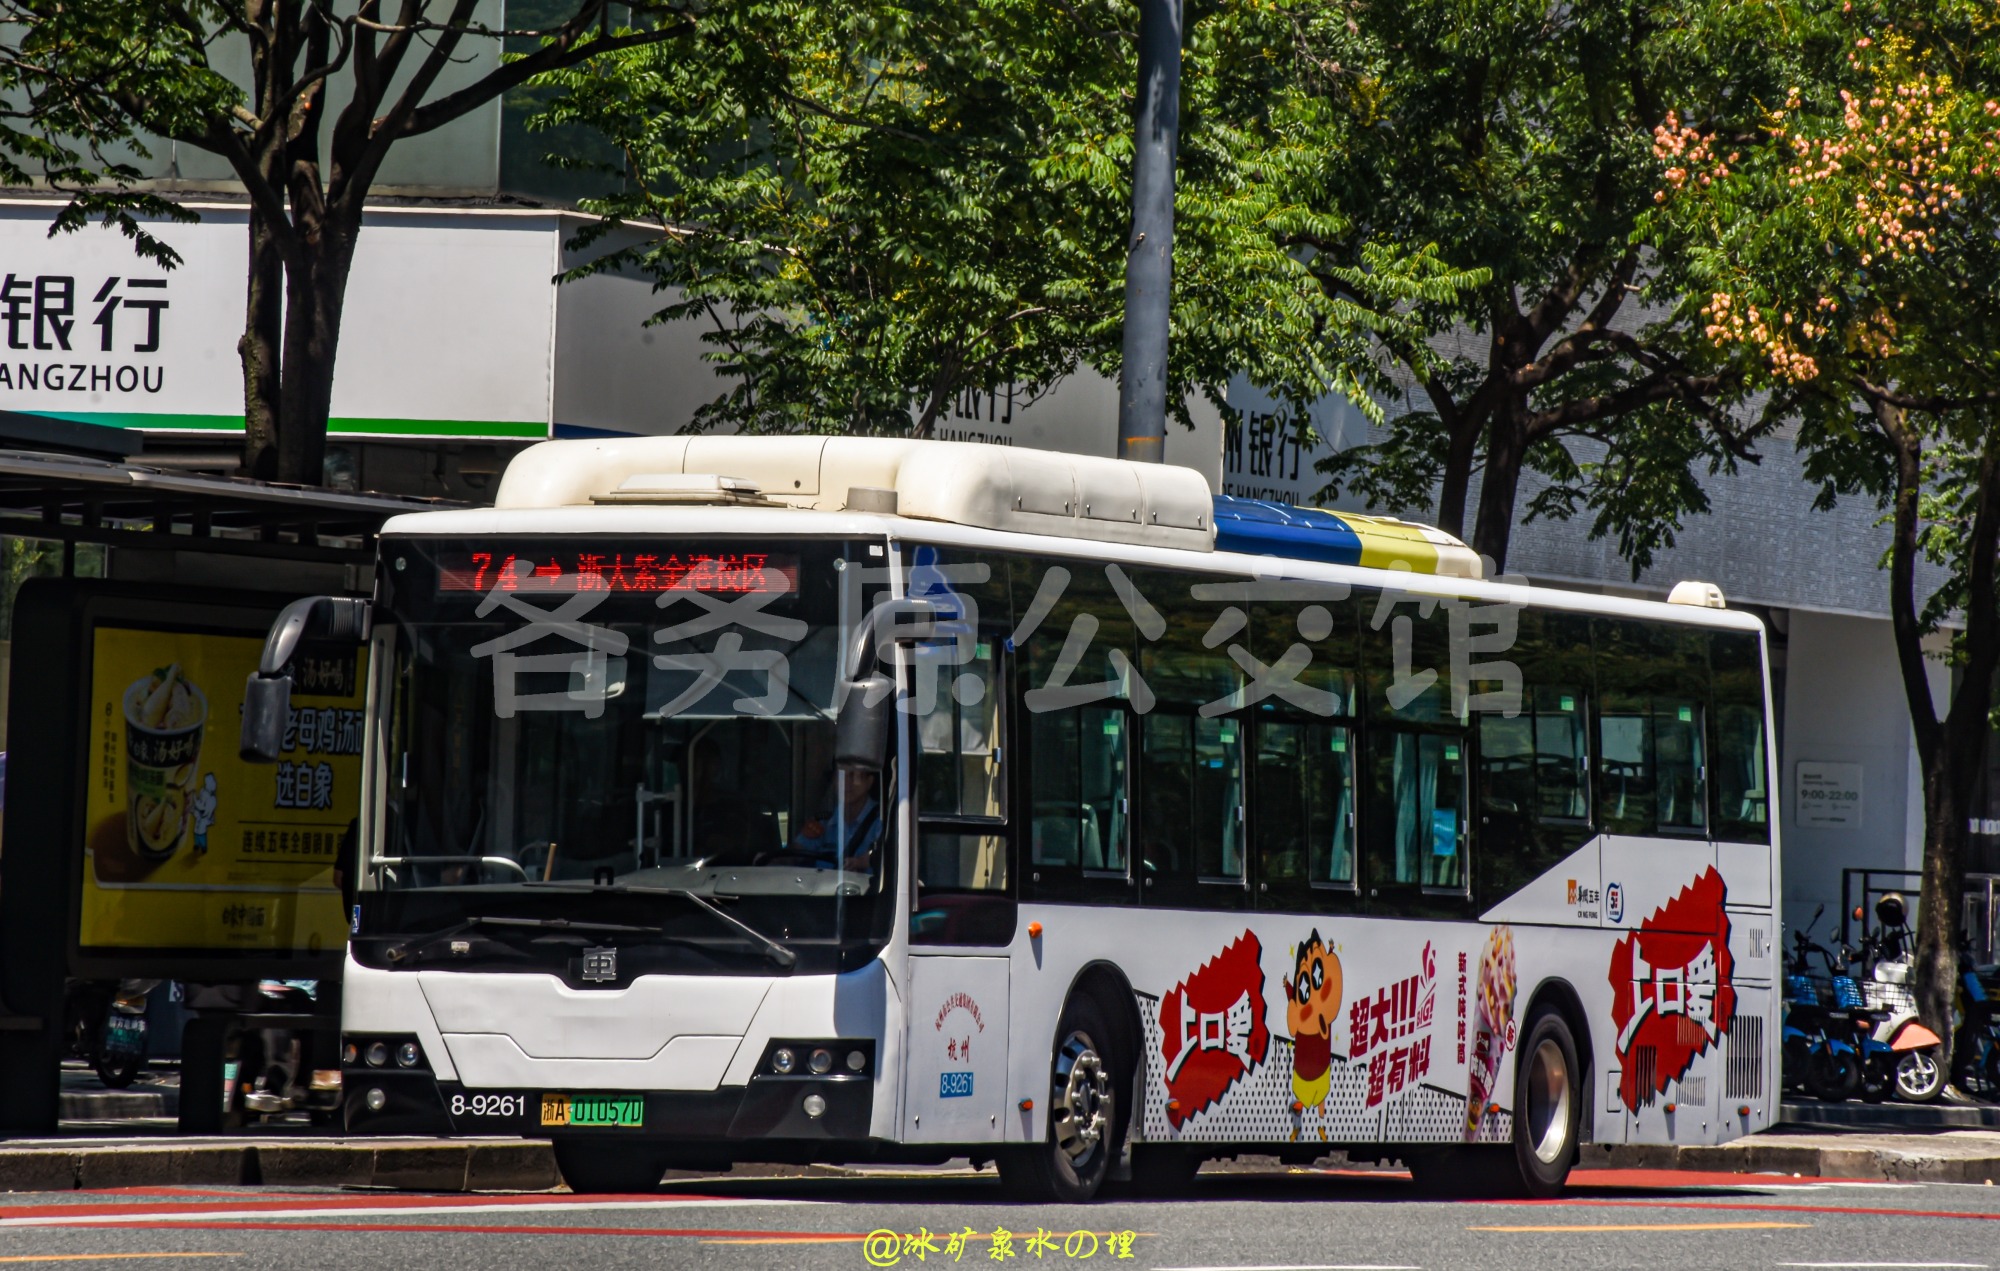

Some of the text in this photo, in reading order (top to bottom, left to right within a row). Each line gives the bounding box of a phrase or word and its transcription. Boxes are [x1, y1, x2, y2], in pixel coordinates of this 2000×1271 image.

[0, 273, 170, 353] 银行
[473, 553, 518, 591] 74
[274, 761, 333, 810] 选白象
[947, 1034, 970, 1064] 杭州
[941, 1074, 973, 1095] 8-9261
[450, 1094, 526, 1117] 8-9261
